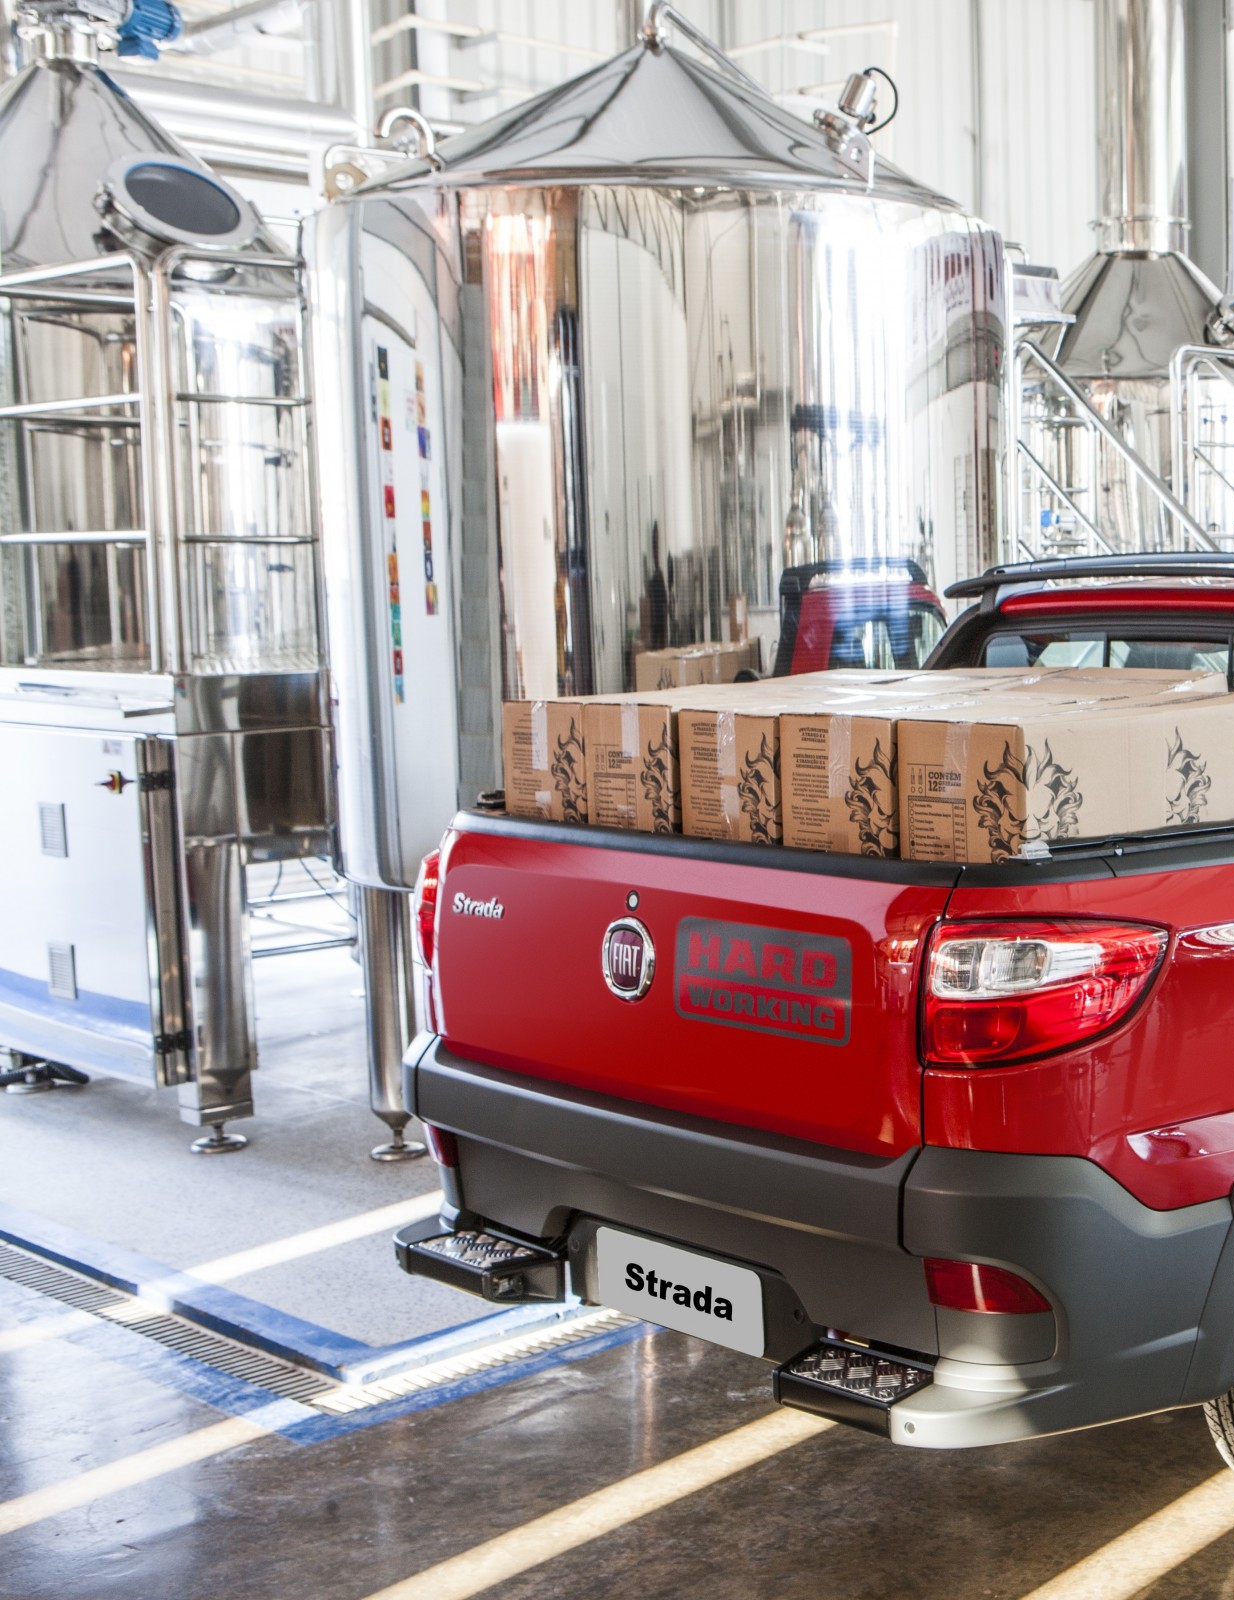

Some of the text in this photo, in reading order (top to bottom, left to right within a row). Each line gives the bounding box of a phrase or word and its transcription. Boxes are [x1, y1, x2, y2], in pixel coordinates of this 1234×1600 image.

[608, 758, 616, 769] 12
[928, 771, 961, 781] CONTÉM
[928, 780, 938, 791] 12
[452, 892, 505, 920] Strada
[613, 942, 640, 978] FIAT
[687, 931, 838, 989] HARD
[688, 984, 836, 1031] WORKING
[625, 1262, 733, 1322] Strada
